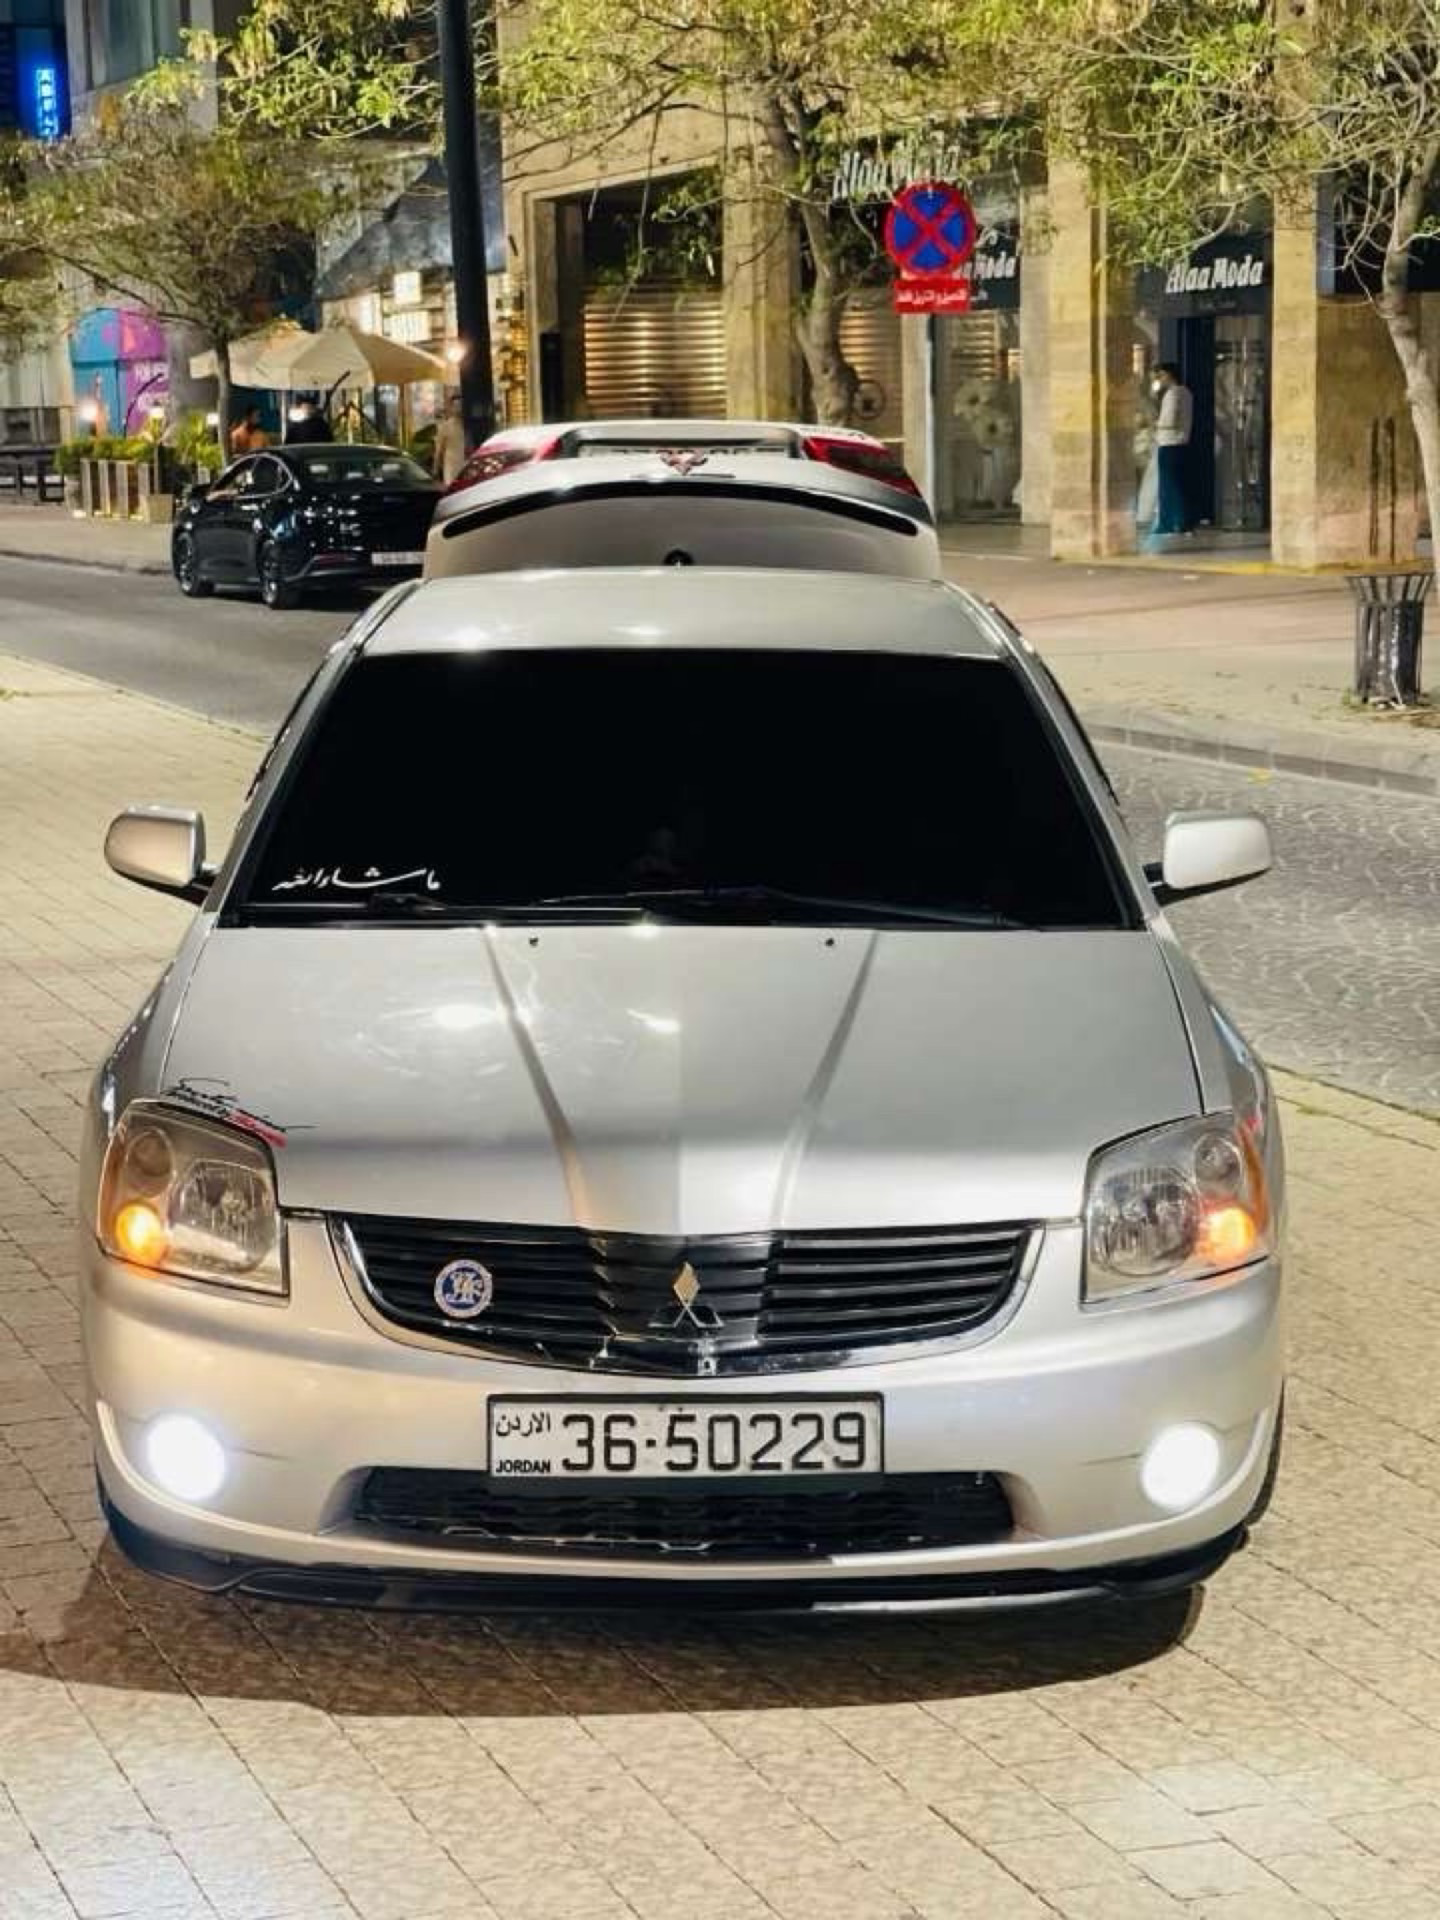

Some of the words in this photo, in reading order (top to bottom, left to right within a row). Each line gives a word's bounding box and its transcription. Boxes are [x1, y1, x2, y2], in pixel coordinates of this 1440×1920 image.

[1211, 254, 1263, 289] Moda
[427, 869, 440, 890] ما
[495, 1459, 551, 1473] JORDAN
